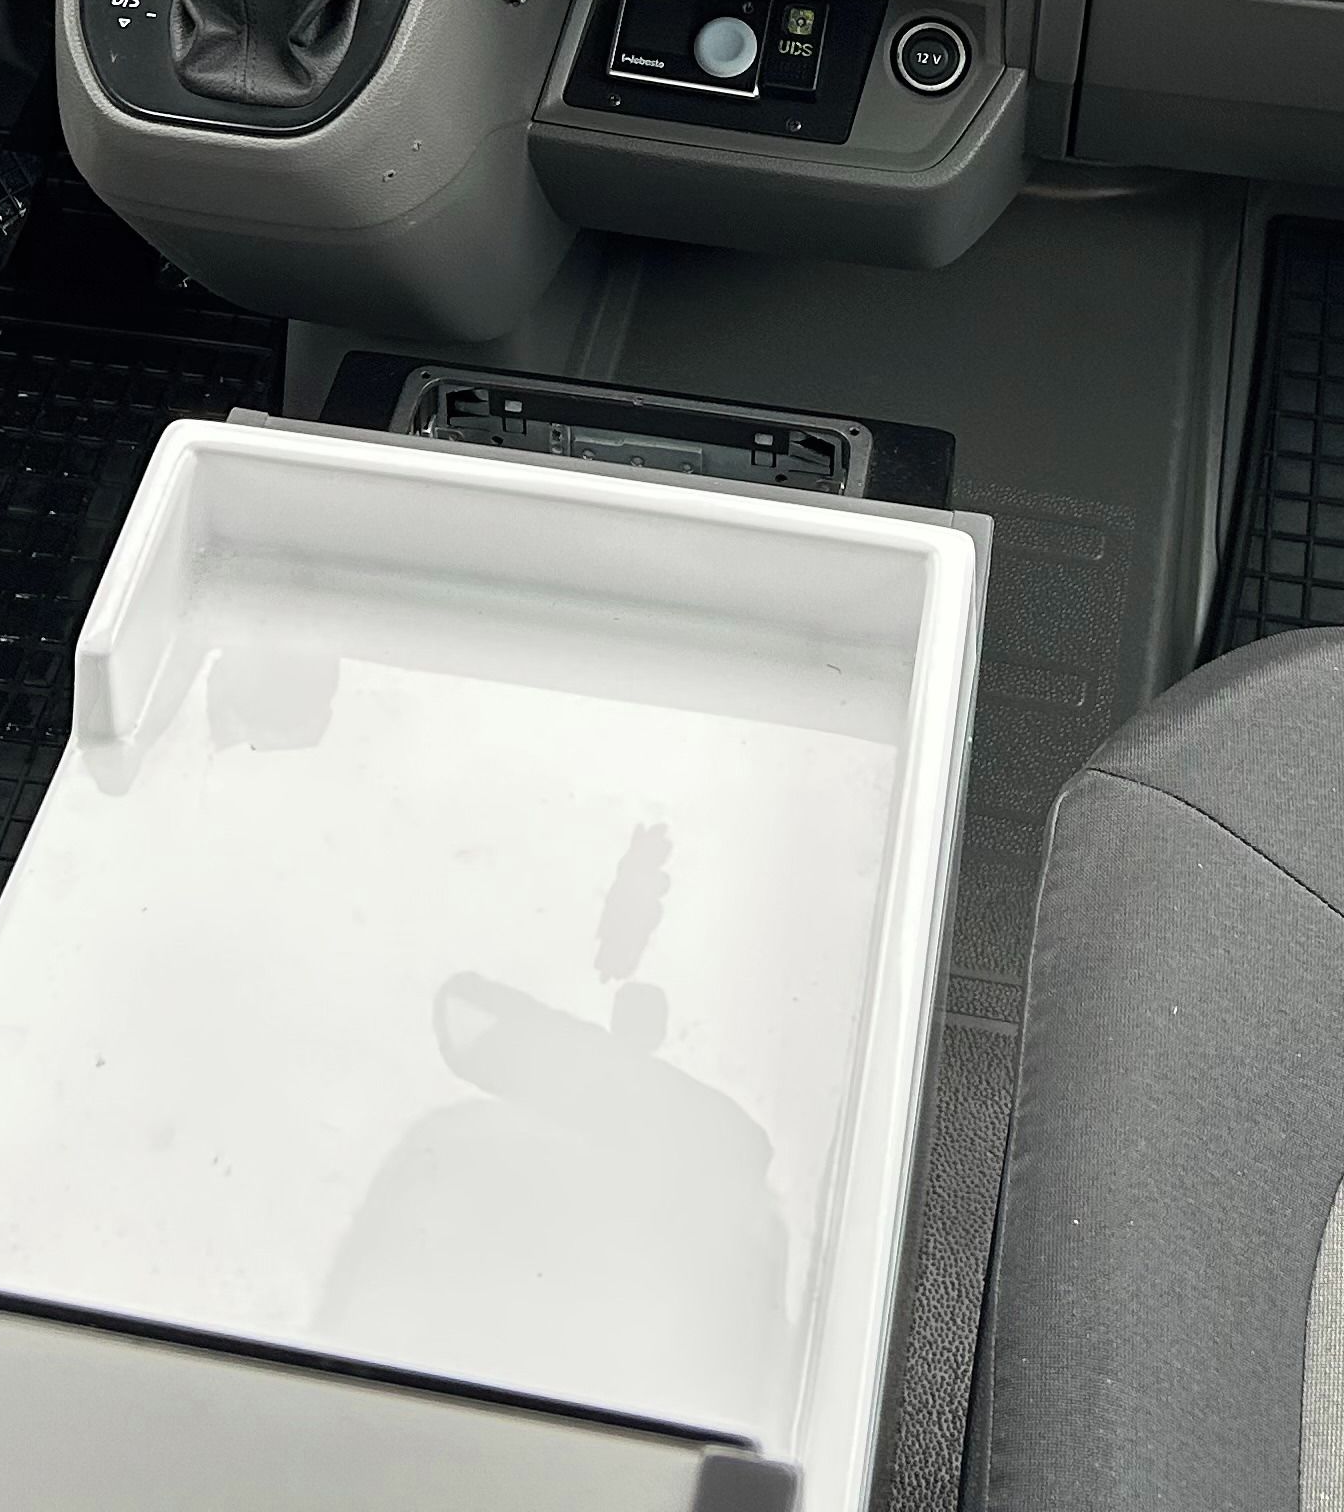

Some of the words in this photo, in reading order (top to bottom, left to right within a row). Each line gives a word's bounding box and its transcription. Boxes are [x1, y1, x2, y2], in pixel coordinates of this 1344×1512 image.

[778, 39, 814, 57] UDS
[916, 52, 929, 64] 12
[932, 54, 942, 65] V
